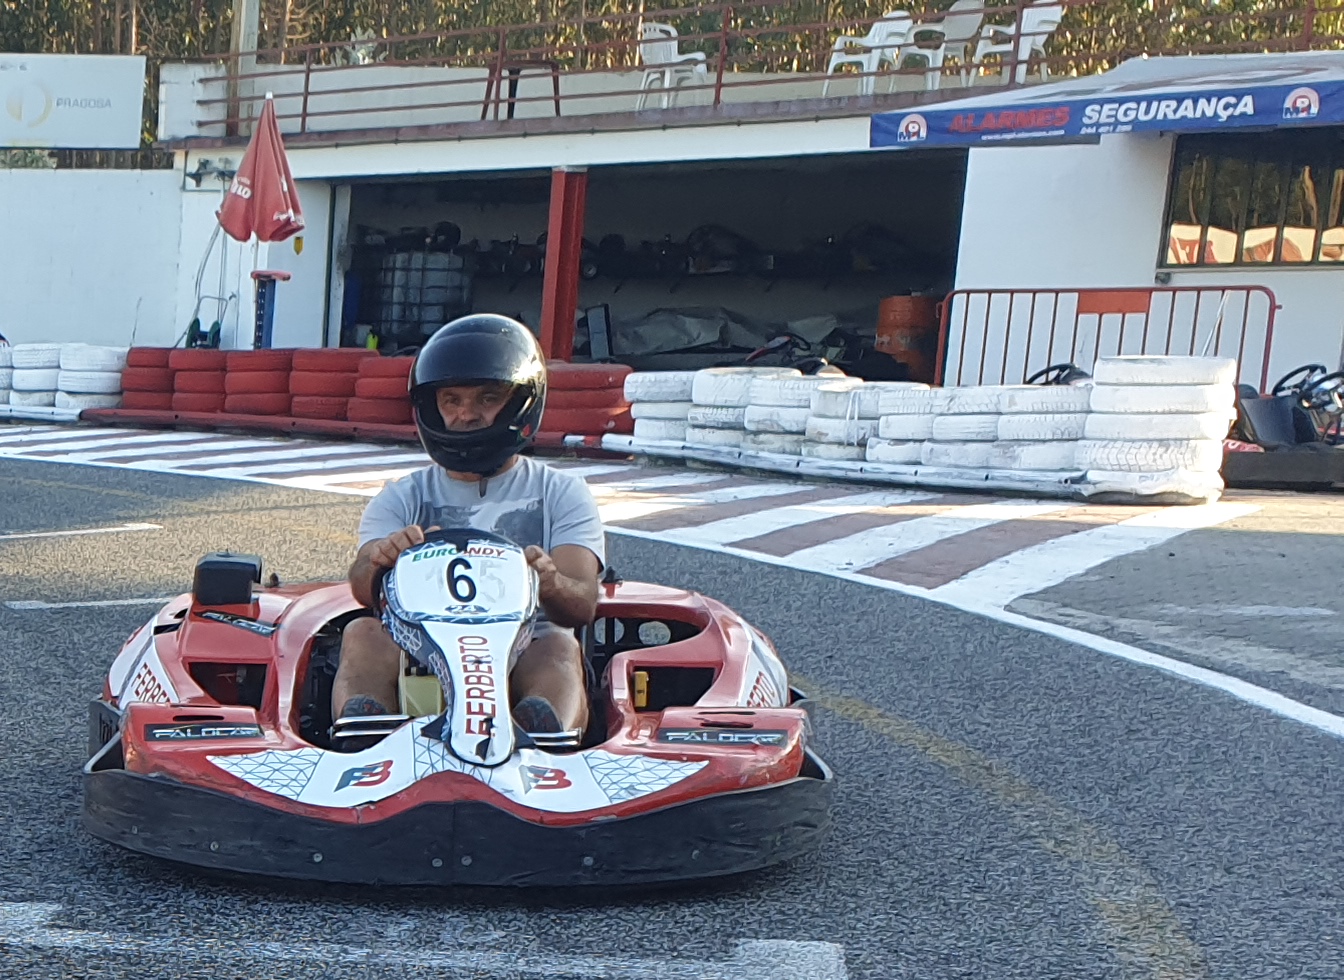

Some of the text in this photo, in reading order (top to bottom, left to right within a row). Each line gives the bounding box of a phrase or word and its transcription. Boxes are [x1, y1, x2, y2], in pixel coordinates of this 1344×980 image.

[948, 95, 1255, 133] ALARMES SEGURANÇA
[446, 557, 477, 603] 6
[457, 635, 496, 738] FERBERTO
[152, 726, 260, 739] PALOCAR
[665, 732, 783, 745] PALOCAR
